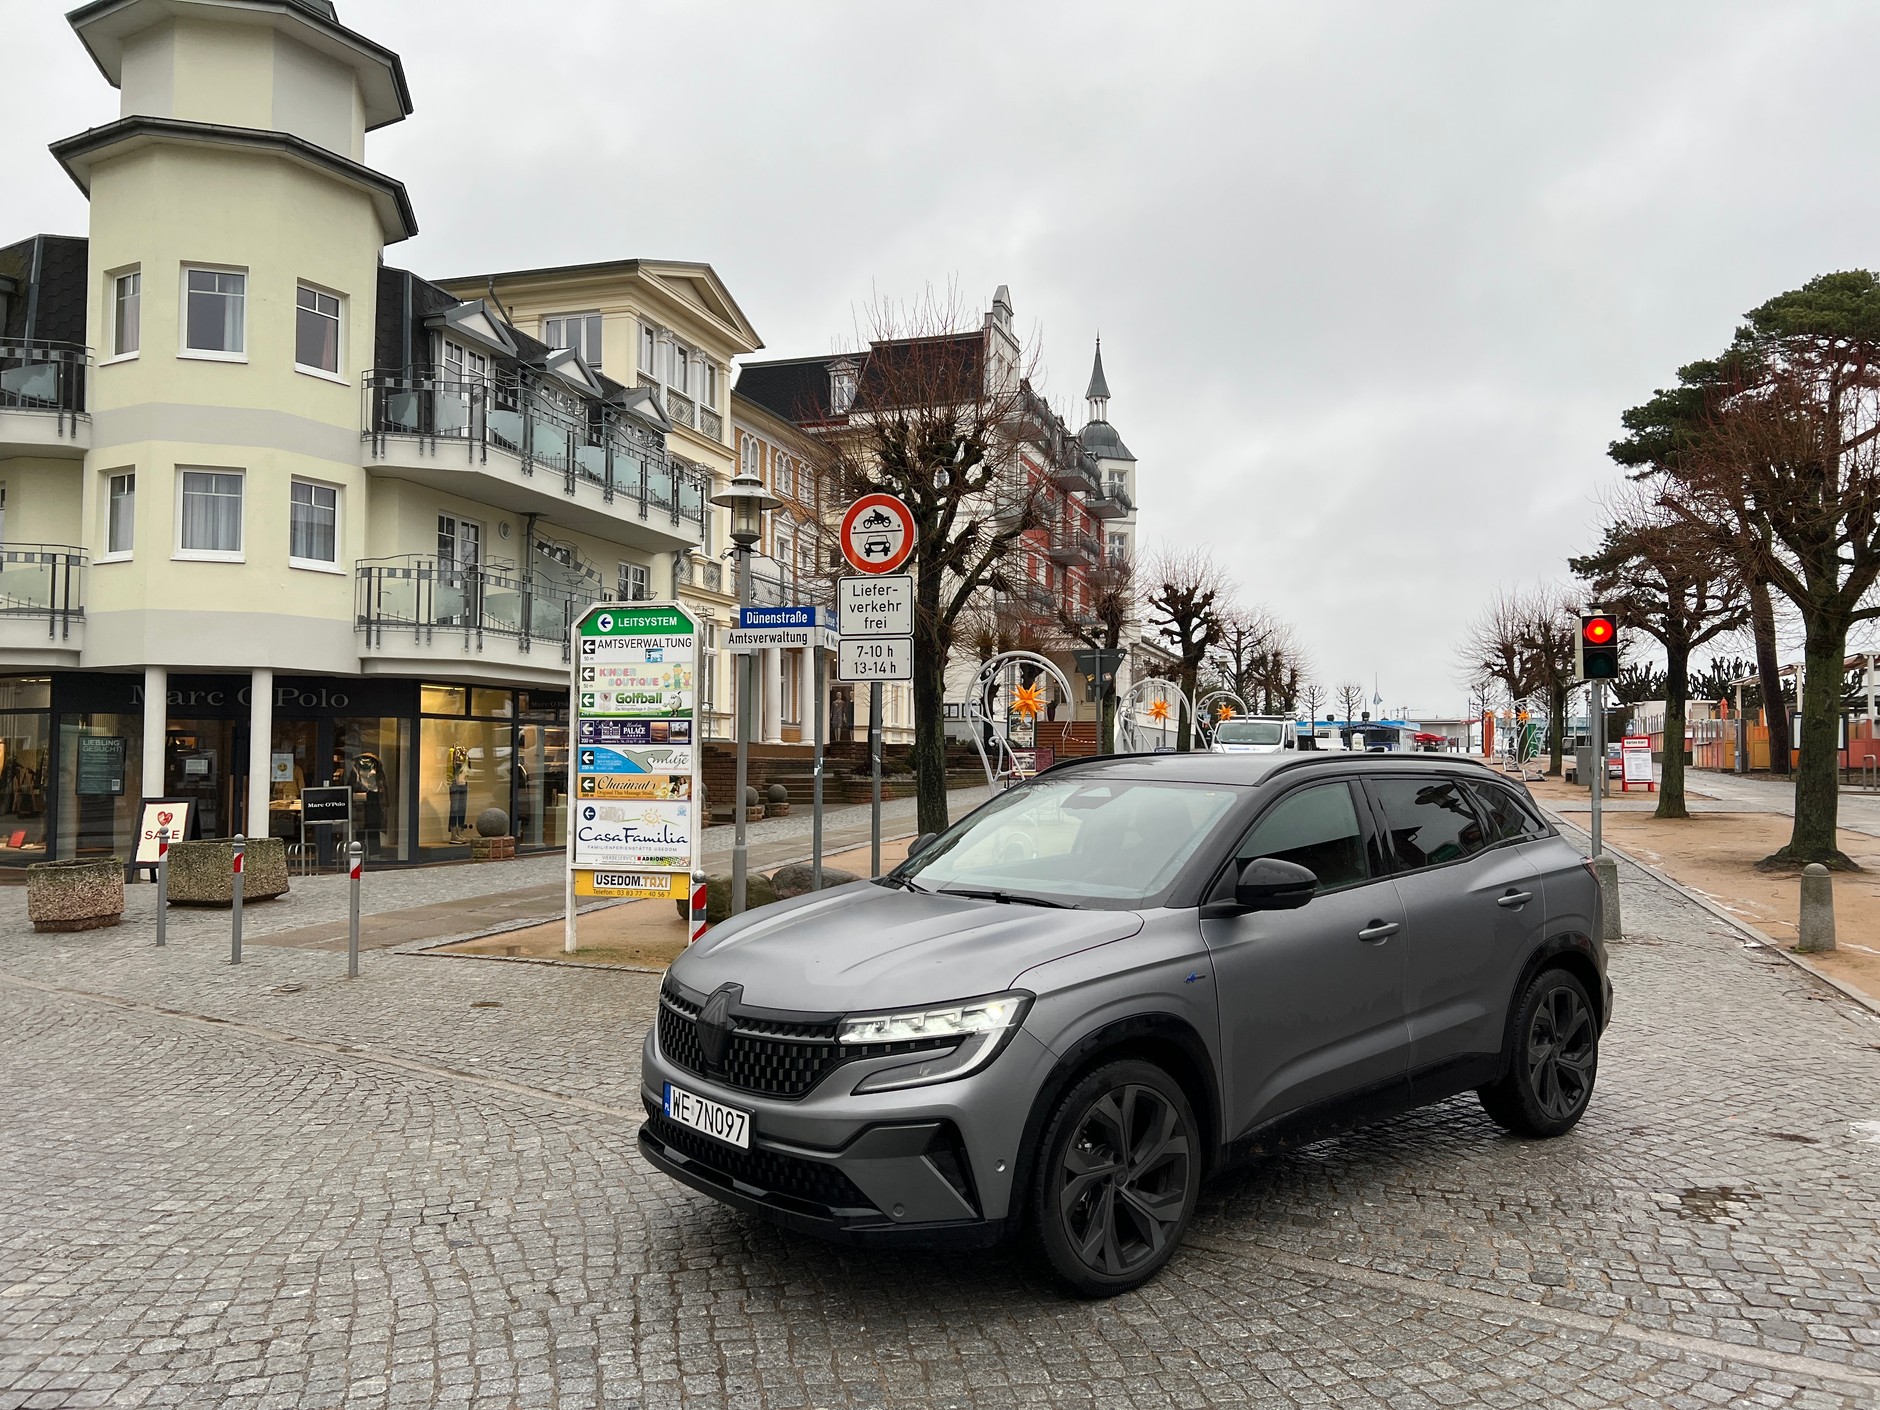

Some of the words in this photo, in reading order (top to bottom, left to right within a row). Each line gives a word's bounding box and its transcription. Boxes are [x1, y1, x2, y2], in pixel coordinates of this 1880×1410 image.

[853, 584, 898, 597] Liefer-
[849, 600, 902, 613] verkehr
[618, 617, 677, 627] LEITSYSTEM
[746, 611, 808, 624] Dünenstraße
[864, 616, 887, 629] frei
[597, 638, 692, 649] AMTSVERWALTUNG
[728, 631, 808, 645] Amtsverwaltung
[857, 645, 882, 657] 7-10
[887, 645, 893, 657] h
[599, 668, 636, 677] KINDER
[854, 661, 886, 674] 13-14
[890, 661, 896, 673] h
[608, 677, 659, 687] BOUTIQUE
[615, 693, 662, 704] Golfball
[623, 727, 646, 735] PALACE
[596, 874, 668, 888] USEDOM.TAXI
[593, 888, 615, 896] Telefon:
[664, 1102, 670, 1112] PL
[673, 1089, 690, 1123] WE
[695, 1098, 745, 1142] 7N097
